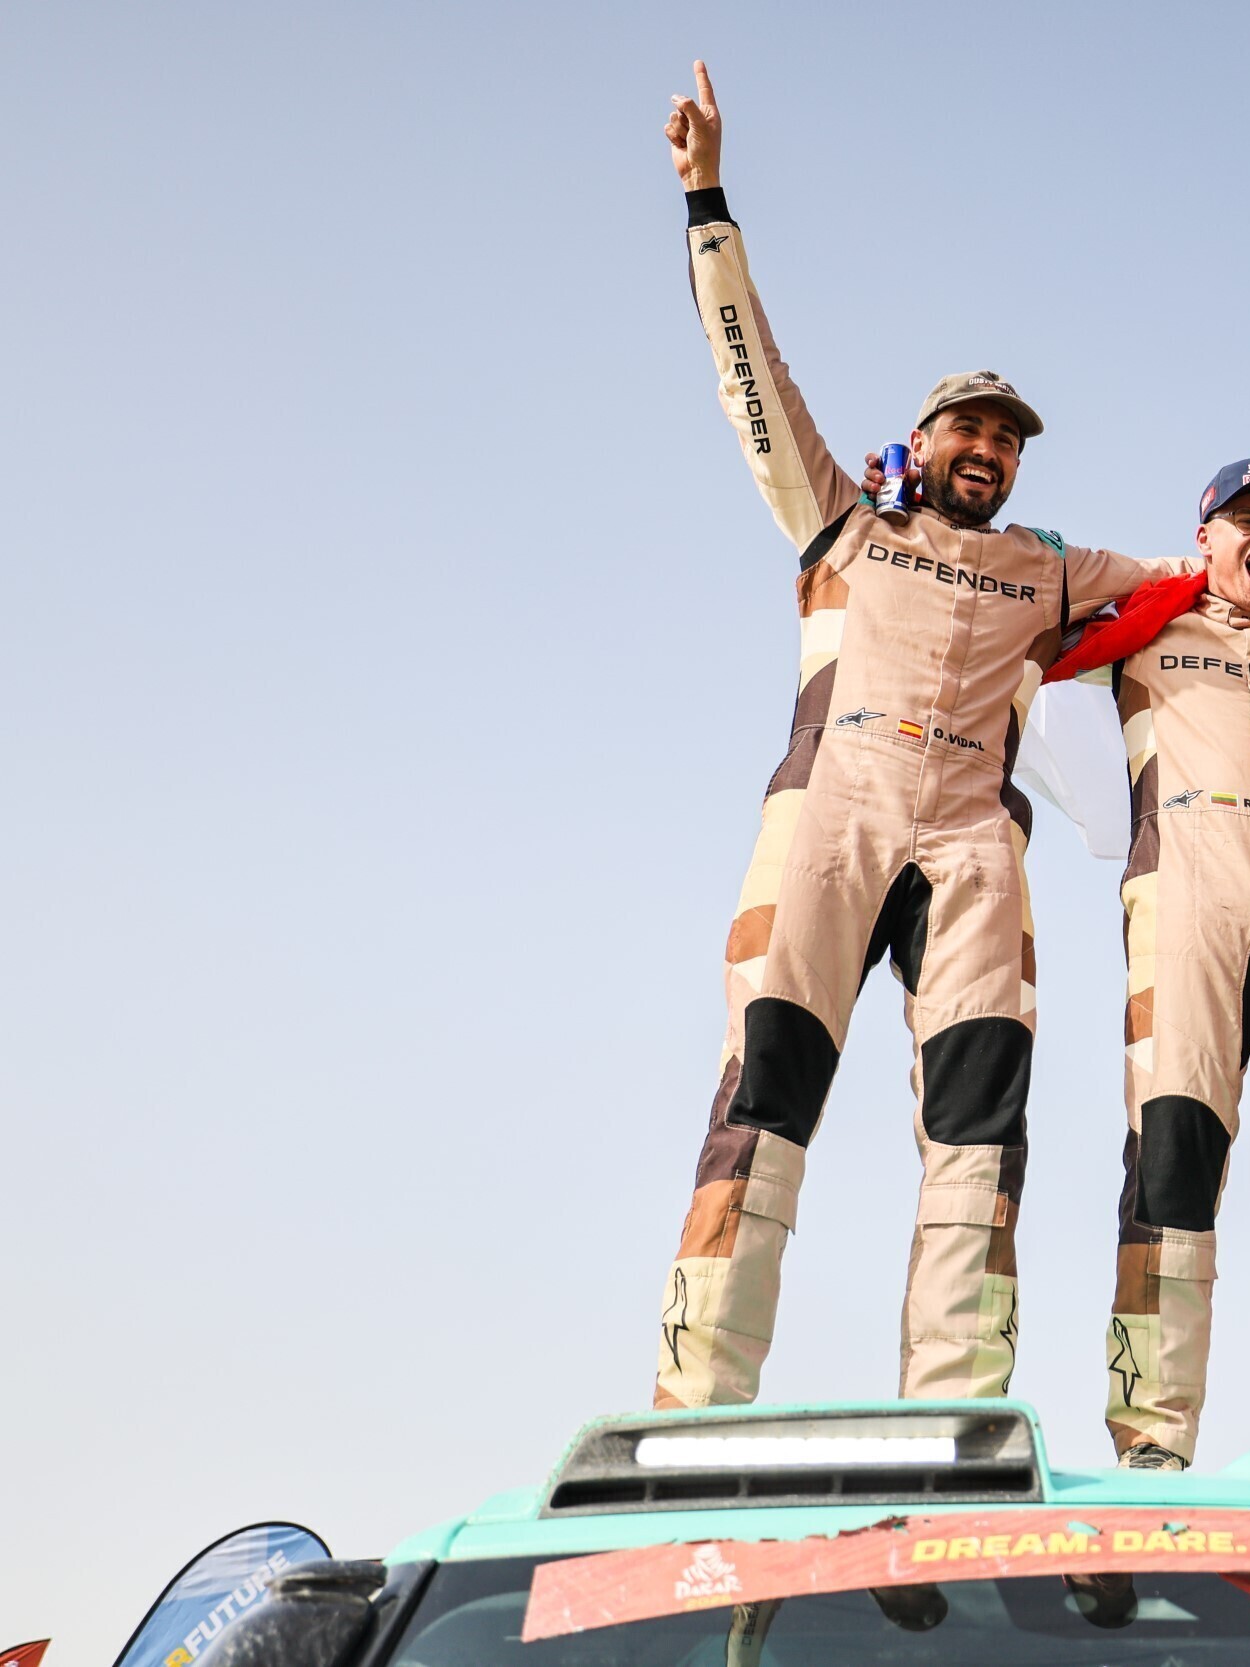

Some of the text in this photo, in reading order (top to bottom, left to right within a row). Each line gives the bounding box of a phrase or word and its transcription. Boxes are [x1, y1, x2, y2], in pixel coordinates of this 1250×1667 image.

[719, 304, 772, 456] DEFENDER
[866, 543, 1036, 604] DEFENDER
[911, 1531, 1101, 1563] DREAM.
[1113, 1531, 1247, 1553] DARE.
